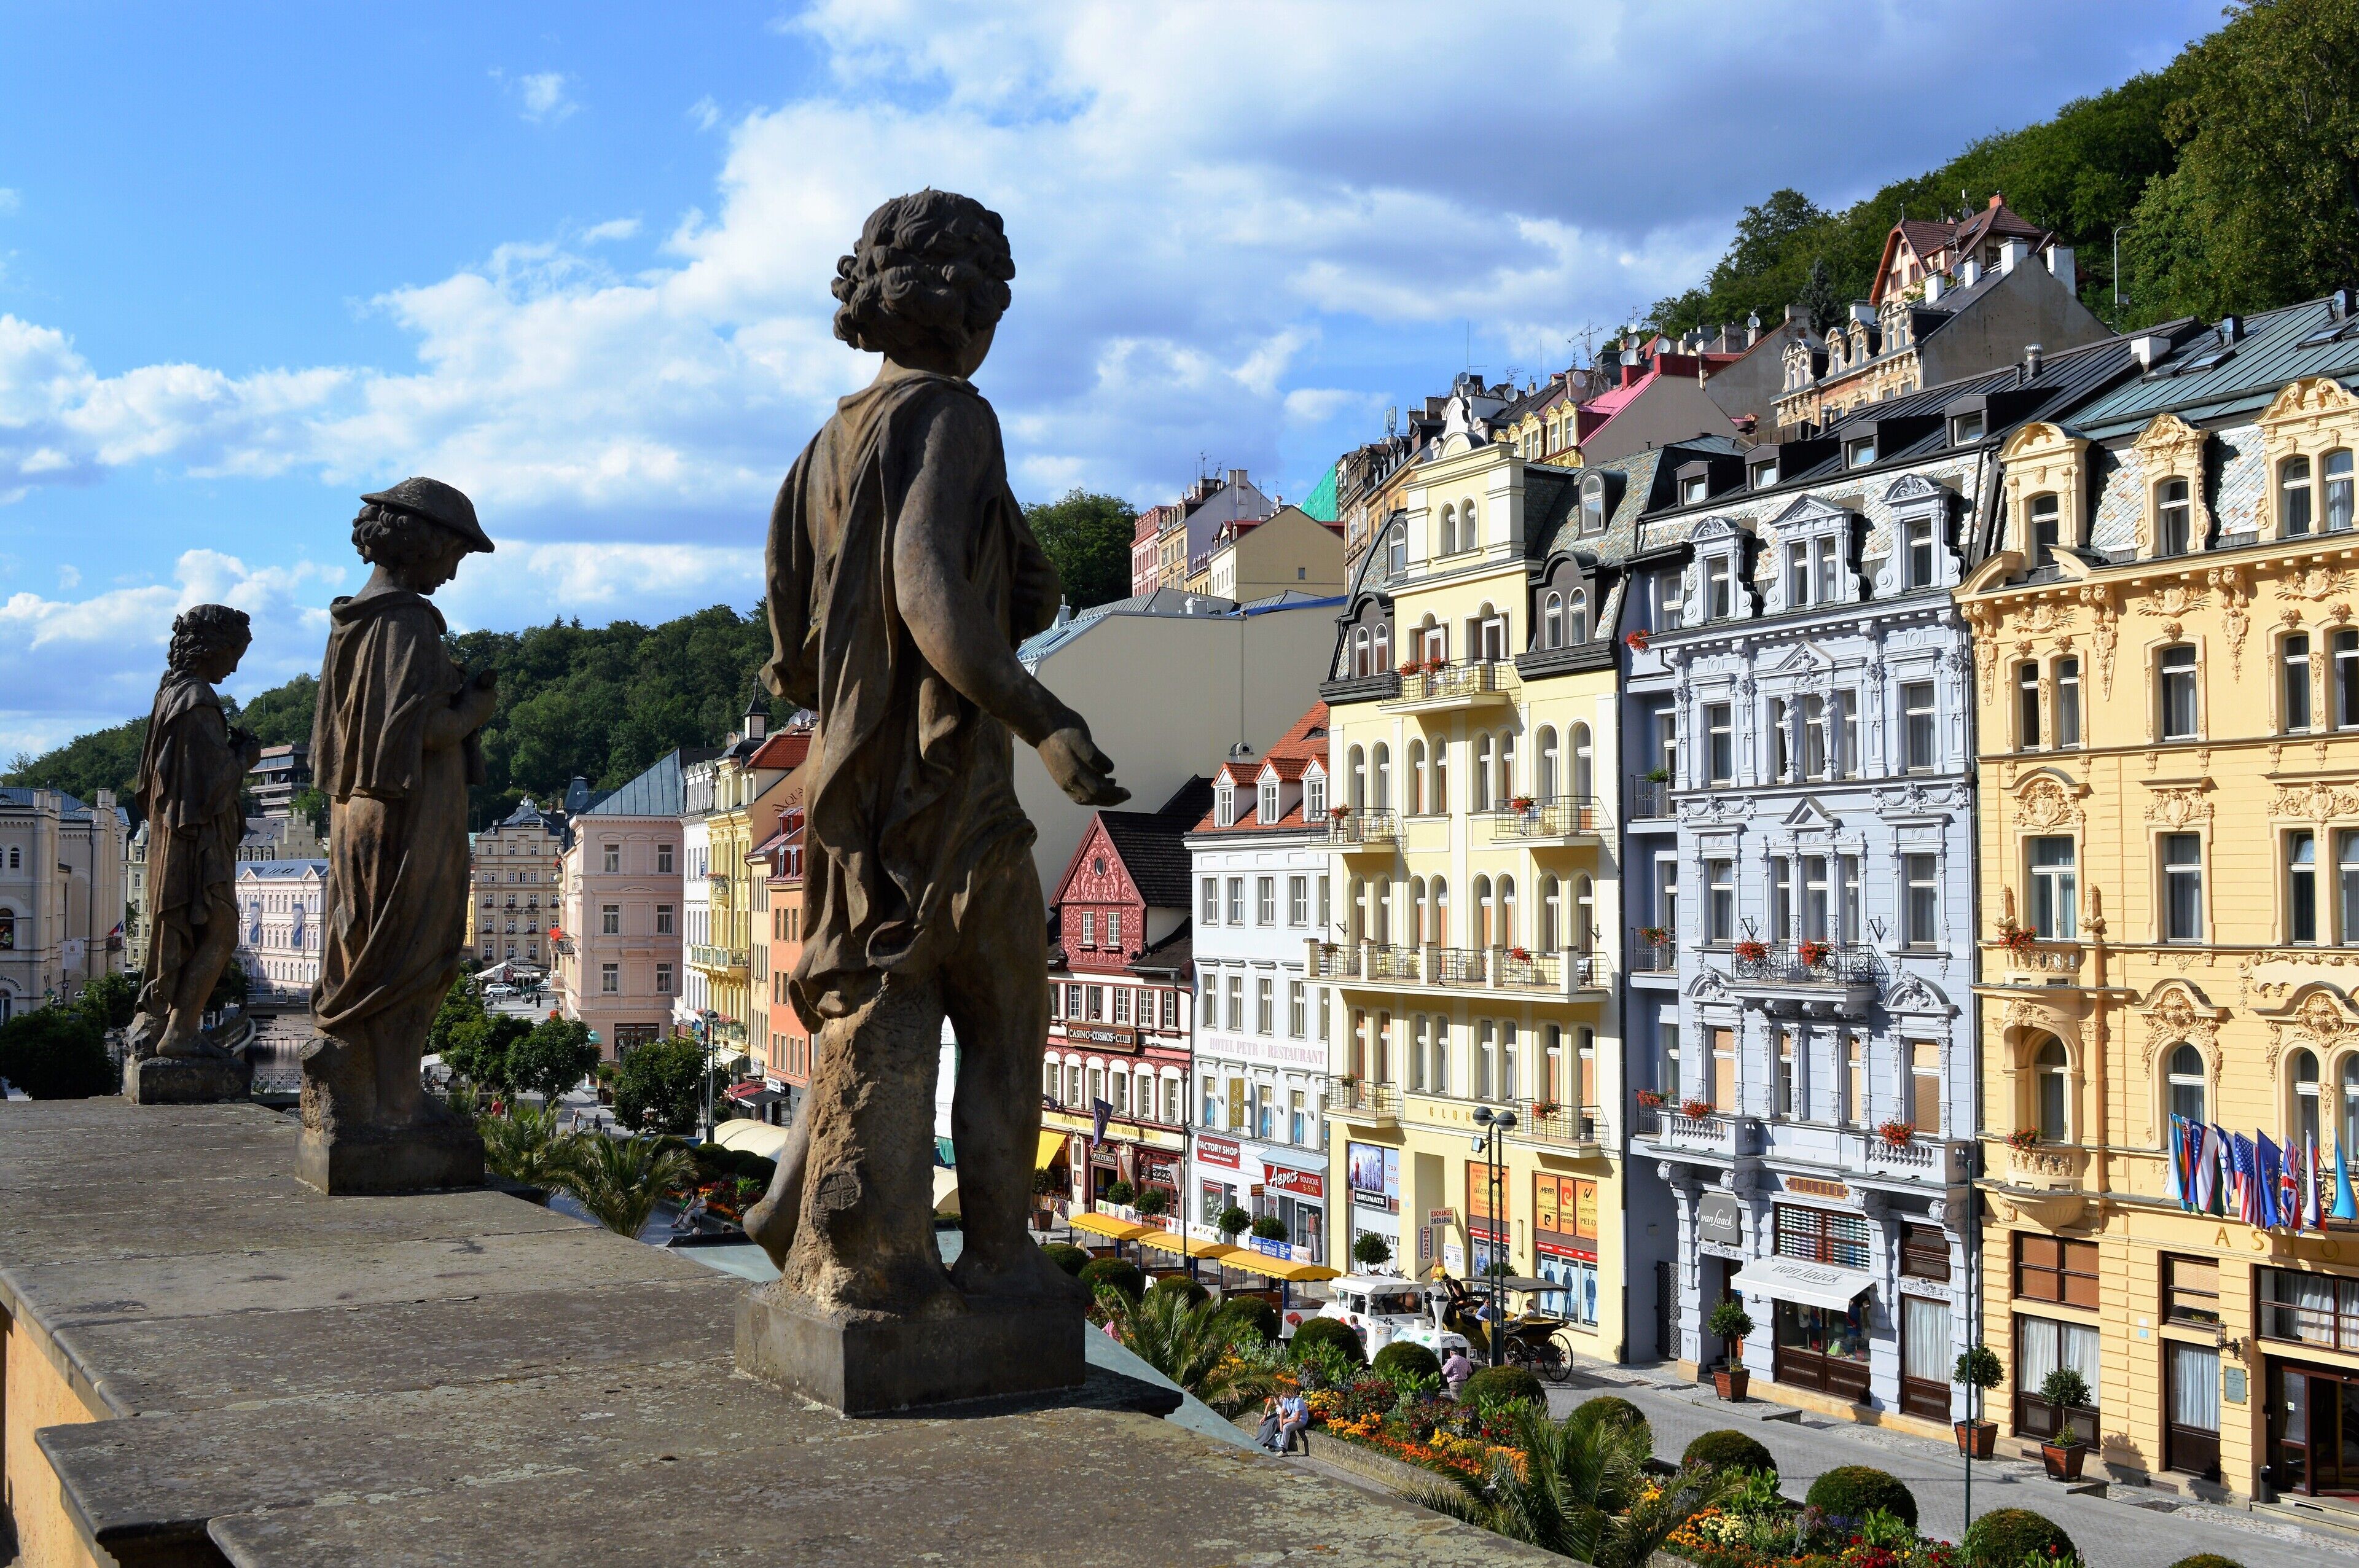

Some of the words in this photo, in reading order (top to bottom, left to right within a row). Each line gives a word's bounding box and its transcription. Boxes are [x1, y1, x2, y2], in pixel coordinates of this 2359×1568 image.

[1069, 1029, 1090, 1039] CASINO
[1092, 1031, 1113, 1042] COSMOS
[1116, 1034, 1131, 1044] CLUB
[1210, 1037, 1234, 1053] HOTEL
[1237, 1041, 1258, 1056] PETR
[1268, 1045, 1324, 1064] RESTAURANT
[1062, 1116, 1078, 1126] HOTEL
[1122, 1127, 1153, 1140] RESTAURANT
[1198, 1140, 1222, 1153] FACTORY
[1222, 1145, 1238, 1157] SHOP
[1093, 1152, 1115, 1163] PIZZERIA
[1388, 1164, 1397, 1172] TAX
[1268, 1166, 1299, 1188] Aspect
[1300, 1175, 1320, 1187] BOUTIQUE
[1386, 1176, 1399, 1185] FREE
[1539, 1187, 1555, 1195] MEYER
[1356, 1193, 1385, 1205] BRUNATE
